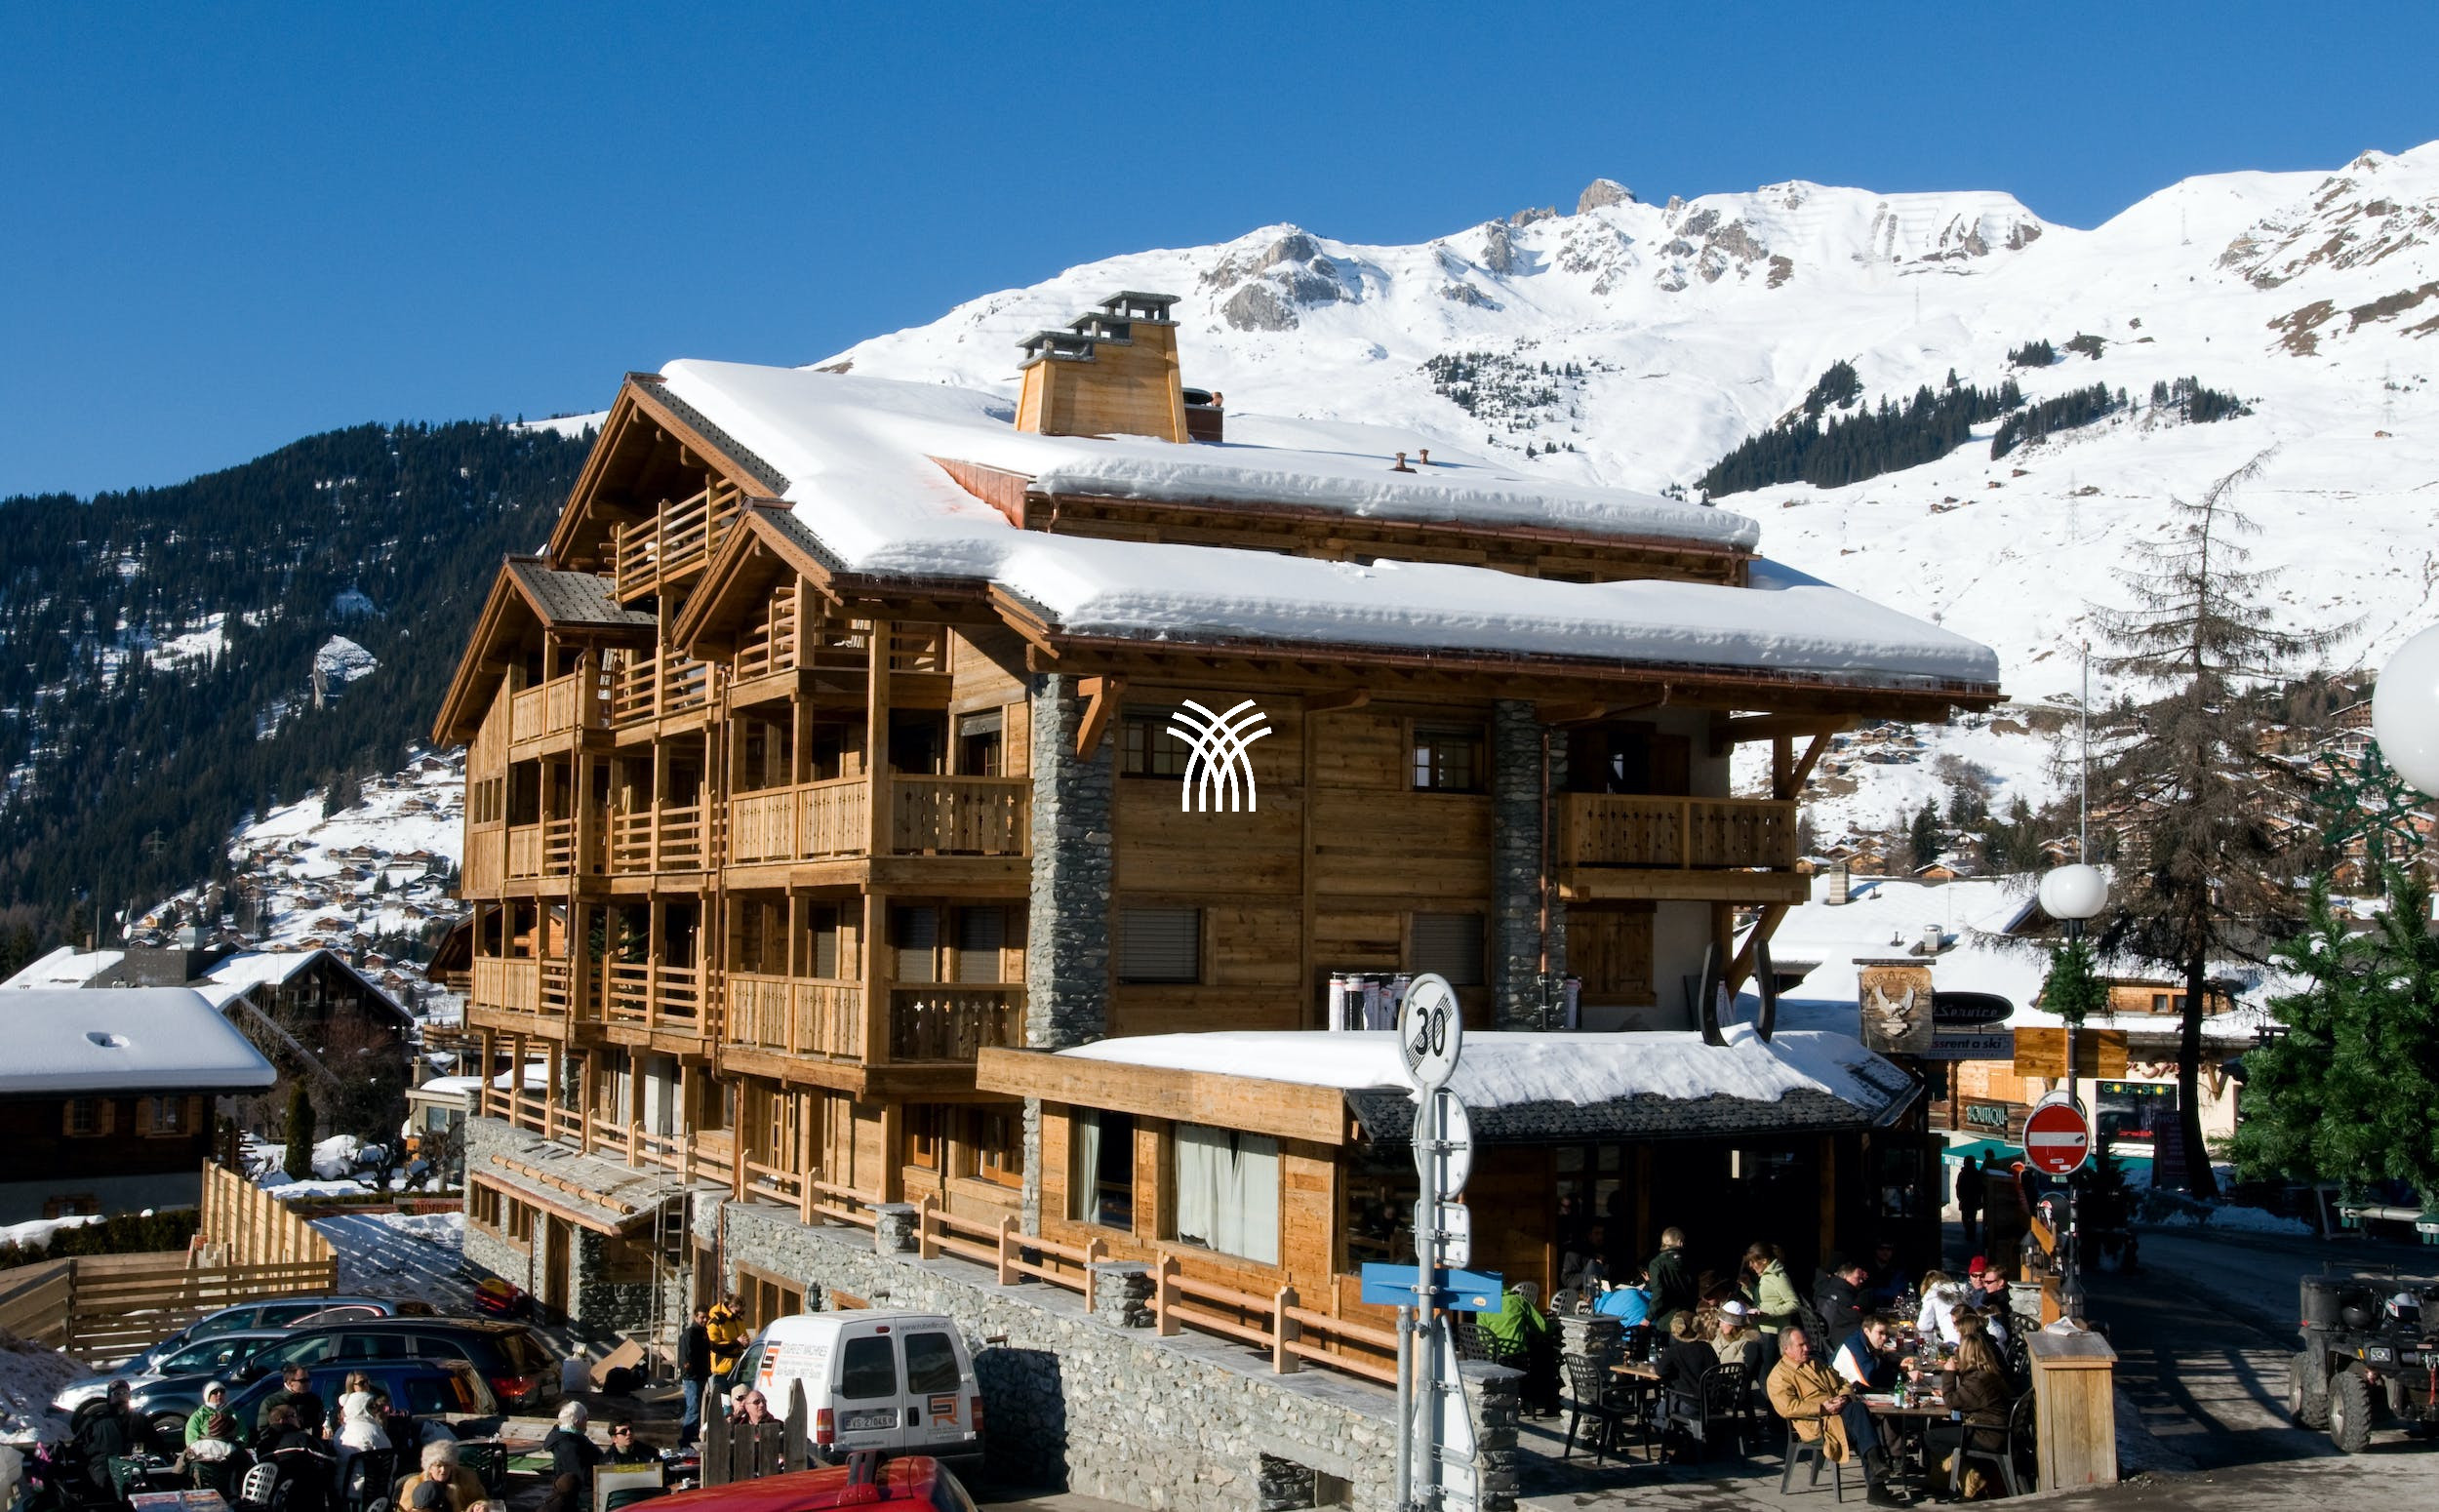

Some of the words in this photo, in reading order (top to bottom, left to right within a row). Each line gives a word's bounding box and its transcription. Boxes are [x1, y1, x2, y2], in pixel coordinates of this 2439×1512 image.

[1415, 1007, 1446, 1057] 30
[1972, 1040, 1980, 1049] a
[1982, 1038, 2002, 1049] ski
[2102, 1083, 2132, 1094] GOLF
[2141, 1084, 2171, 1095] SHOP
[1967, 1105, 2008, 1127] BOUTIQU
